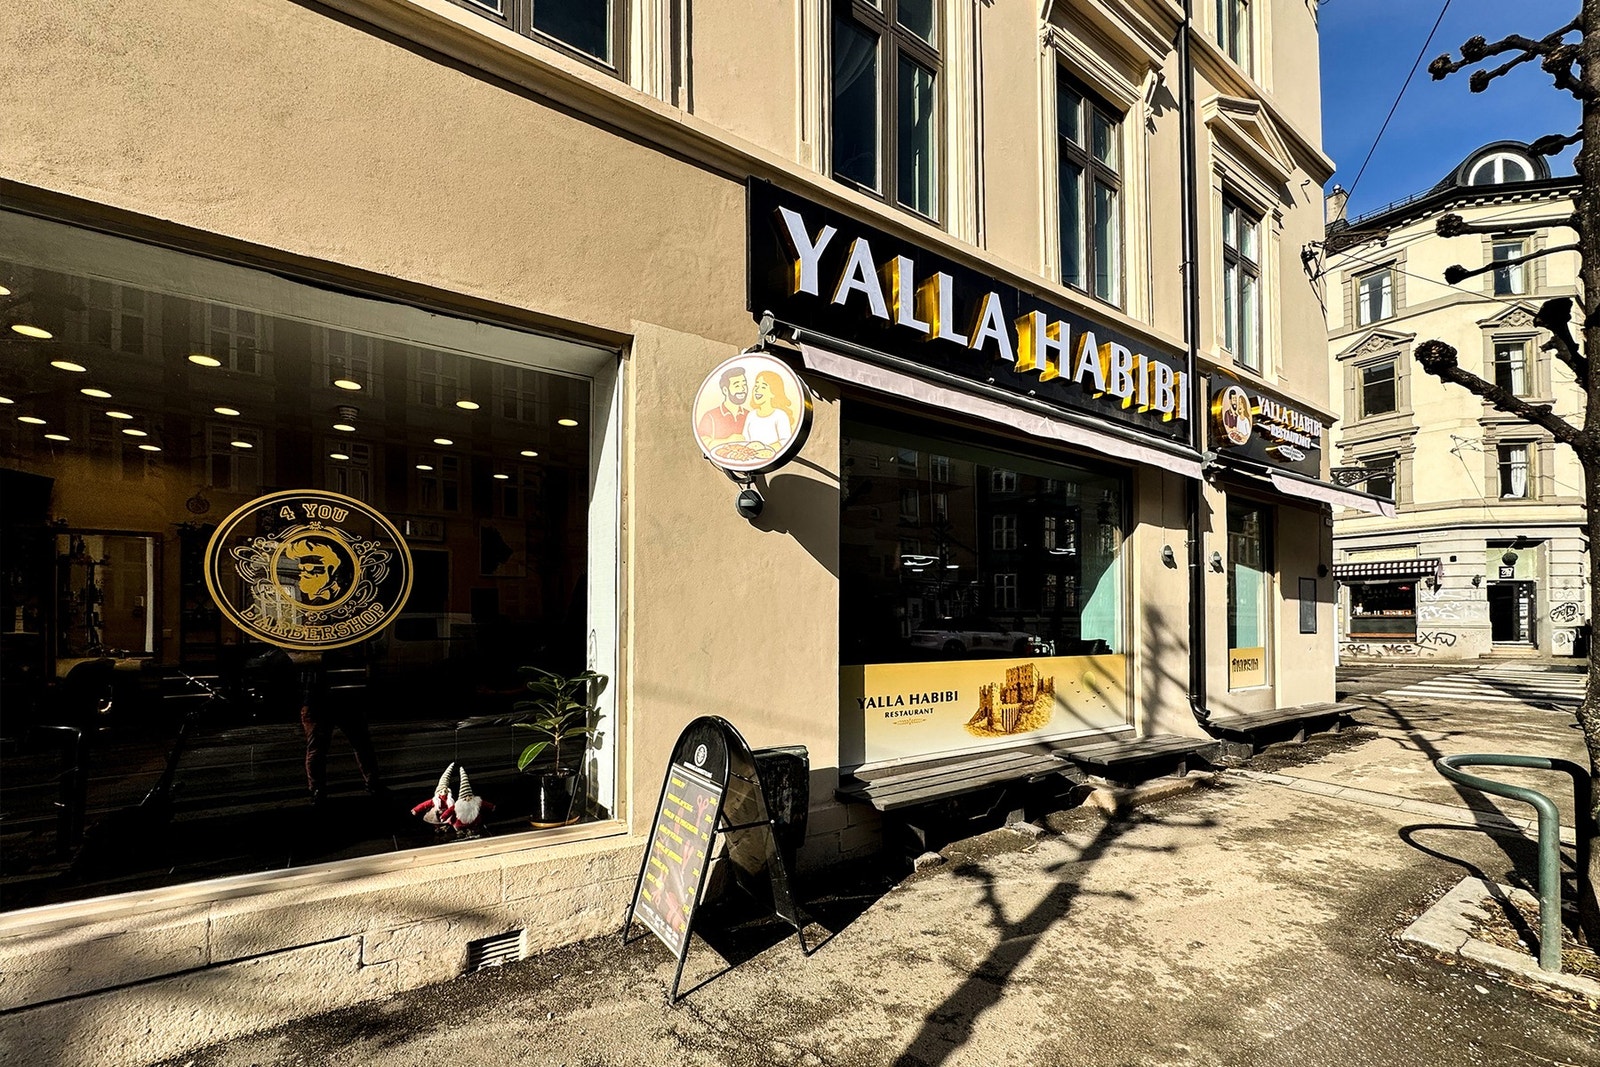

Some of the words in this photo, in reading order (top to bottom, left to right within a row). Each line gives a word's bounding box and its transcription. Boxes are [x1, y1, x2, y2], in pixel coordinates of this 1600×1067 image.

[777, 205, 1015, 362] YALLA
[1033, 310, 1188, 421] HABIBI
[1256, 395, 1288, 425] YALLA
[1290, 410, 1322, 437] HABIBI
[279, 505, 295, 521] 4
[302, 503, 349, 522] YOU
[240, 602, 385, 641] BARBERSHOP
[857, 694, 904, 710] YALLA
[909, 691, 958, 705] HABIBI
[884, 708, 934, 718] RESTAURANT
